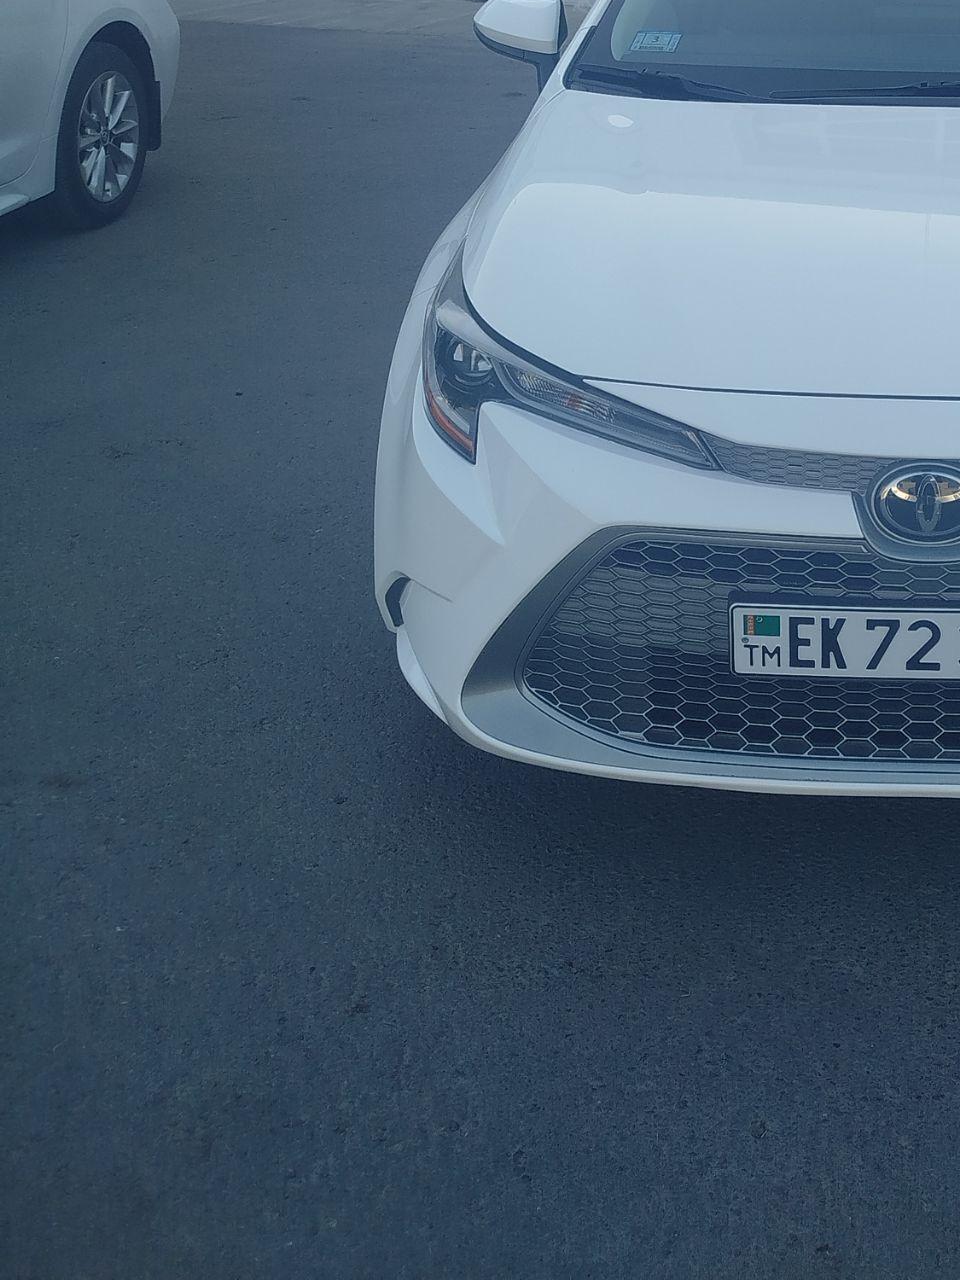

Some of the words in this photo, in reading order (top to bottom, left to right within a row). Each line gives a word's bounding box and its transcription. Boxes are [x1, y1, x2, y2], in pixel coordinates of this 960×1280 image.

[743, 644, 782, 668] TM
[788, 616, 848, 670] EK
[866, 619, 942, 671] 72
